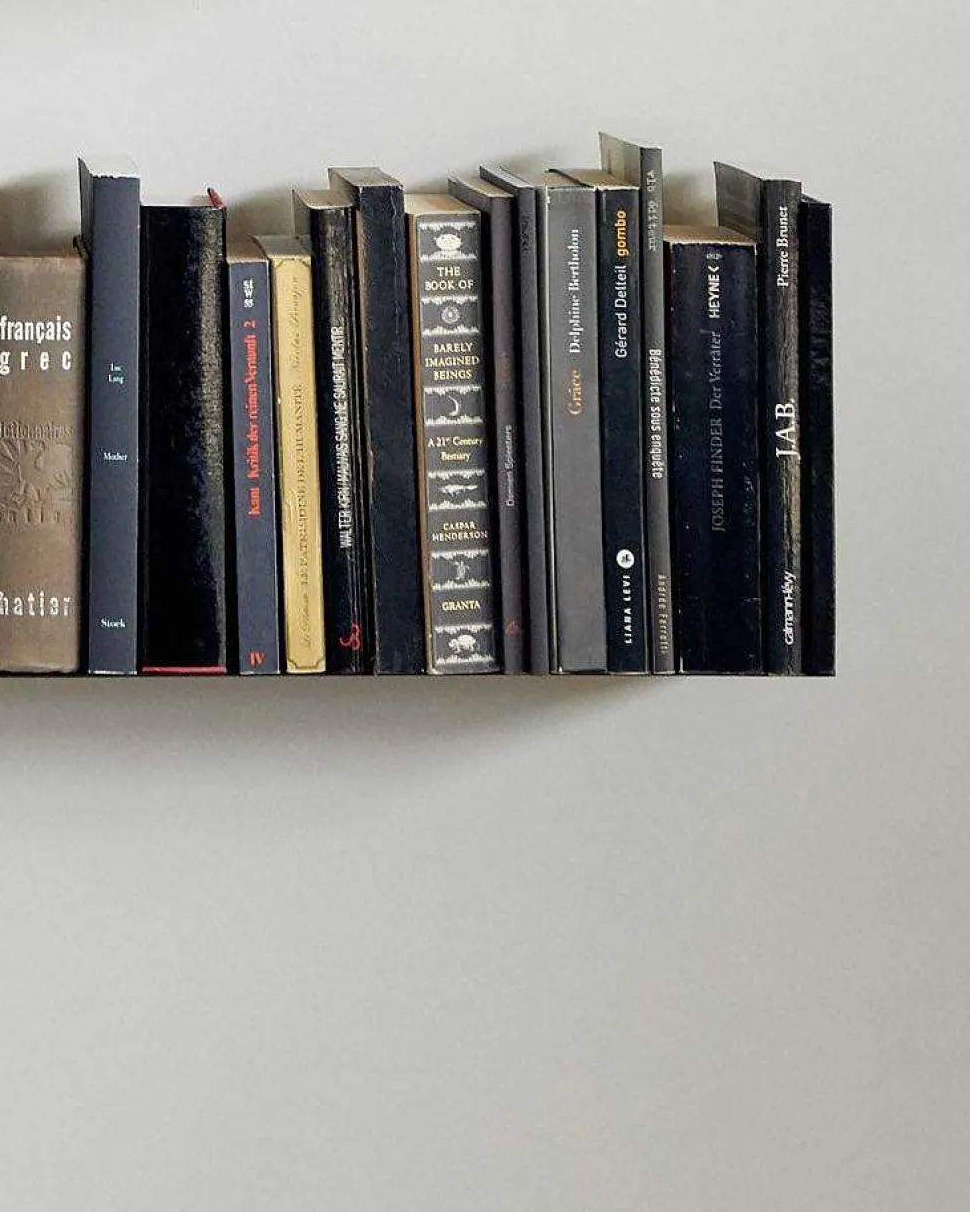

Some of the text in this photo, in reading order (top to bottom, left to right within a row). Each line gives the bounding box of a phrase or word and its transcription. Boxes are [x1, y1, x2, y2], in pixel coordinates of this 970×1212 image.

[614, 210, 630, 257] gombo
[776, 205, 789, 288] Pierre Brunet
[436, 266, 461, 277] THE
[425, 279, 474, 291] BOOK OF
[567, 229, 584, 354] Delphine Bertholon
[707, 274, 720, 319] HEYNE
[243, 320, 256, 329] 2
[614, 265, 628, 358] Gérard Delteil
[0, 315, 73, 344] français
[433, 341, 473, 353] BARELY
[425, 356, 480, 368] IMAGINED
[433, 370, 472, 381] BEINGS
[649, 348, 663, 404] Bénédicte
[245, 384, 259, 420] reinen
[709, 387, 723, 410] Der
[246, 422, 259, 442] der
[650, 406, 661, 432] sous
[775, 398, 802, 461] J.A.B.
[427, 438, 434, 448] A
[452, 436, 484, 448] Century
[710, 417, 726, 532] JOSEPH FINDER
[338, 509, 352, 548] WALTER
[432, 531, 489, 542] HENDERSON
[443, 521, 476, 531] CASPAR
[0, 591, 72, 617] hatier
[441, 600, 482, 612] GRANTA
[622, 575, 633, 644] LIANA LEVI
[101, 617, 126, 630] Stock
